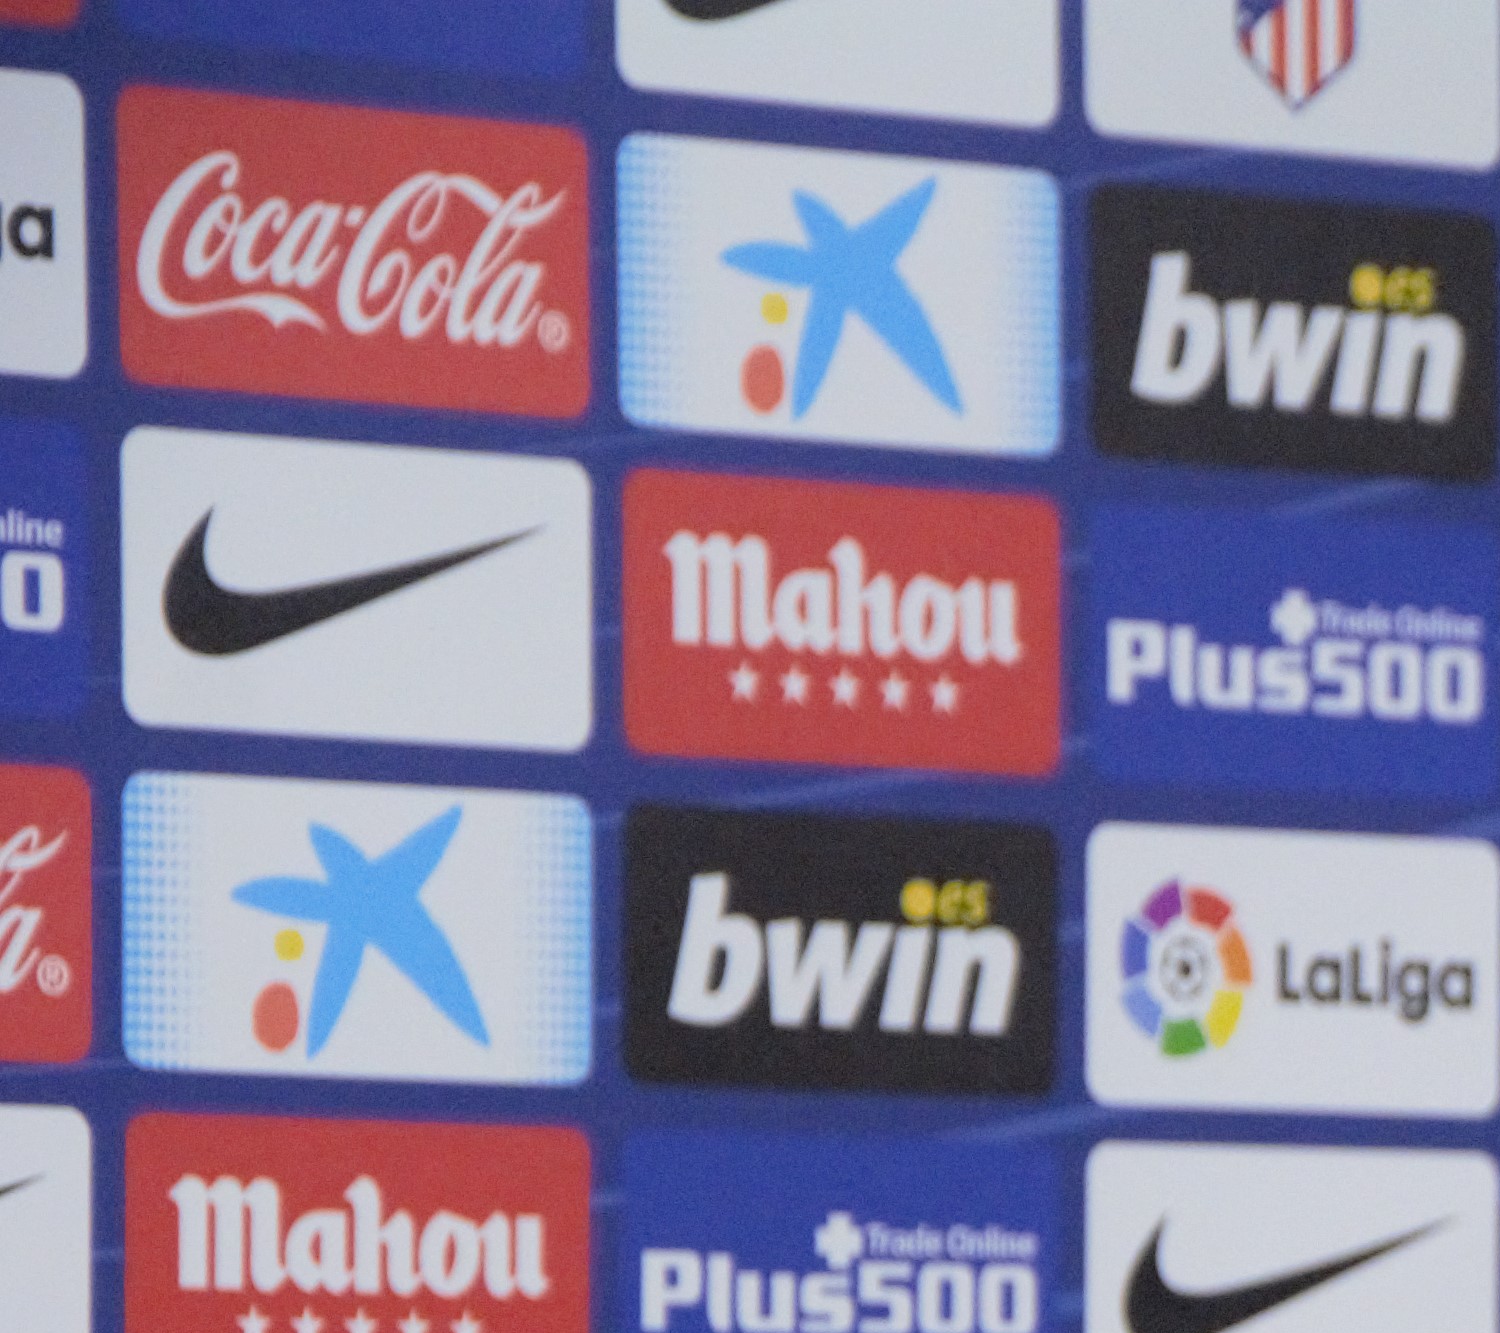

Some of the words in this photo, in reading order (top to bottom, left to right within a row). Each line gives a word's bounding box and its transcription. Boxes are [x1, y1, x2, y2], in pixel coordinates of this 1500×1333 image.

[137, 152, 569, 350] Coca-Cola
[1132, 252, 1463, 421] bwin
[665, 531, 1021, 664] Mahou
[1107, 617, 1484, 723] Plus500
[669, 873, 1019, 1034] bwin
[1277, 941, 1474, 1021] LaLiga
[170, 1175, 548, 1298] Mahou
